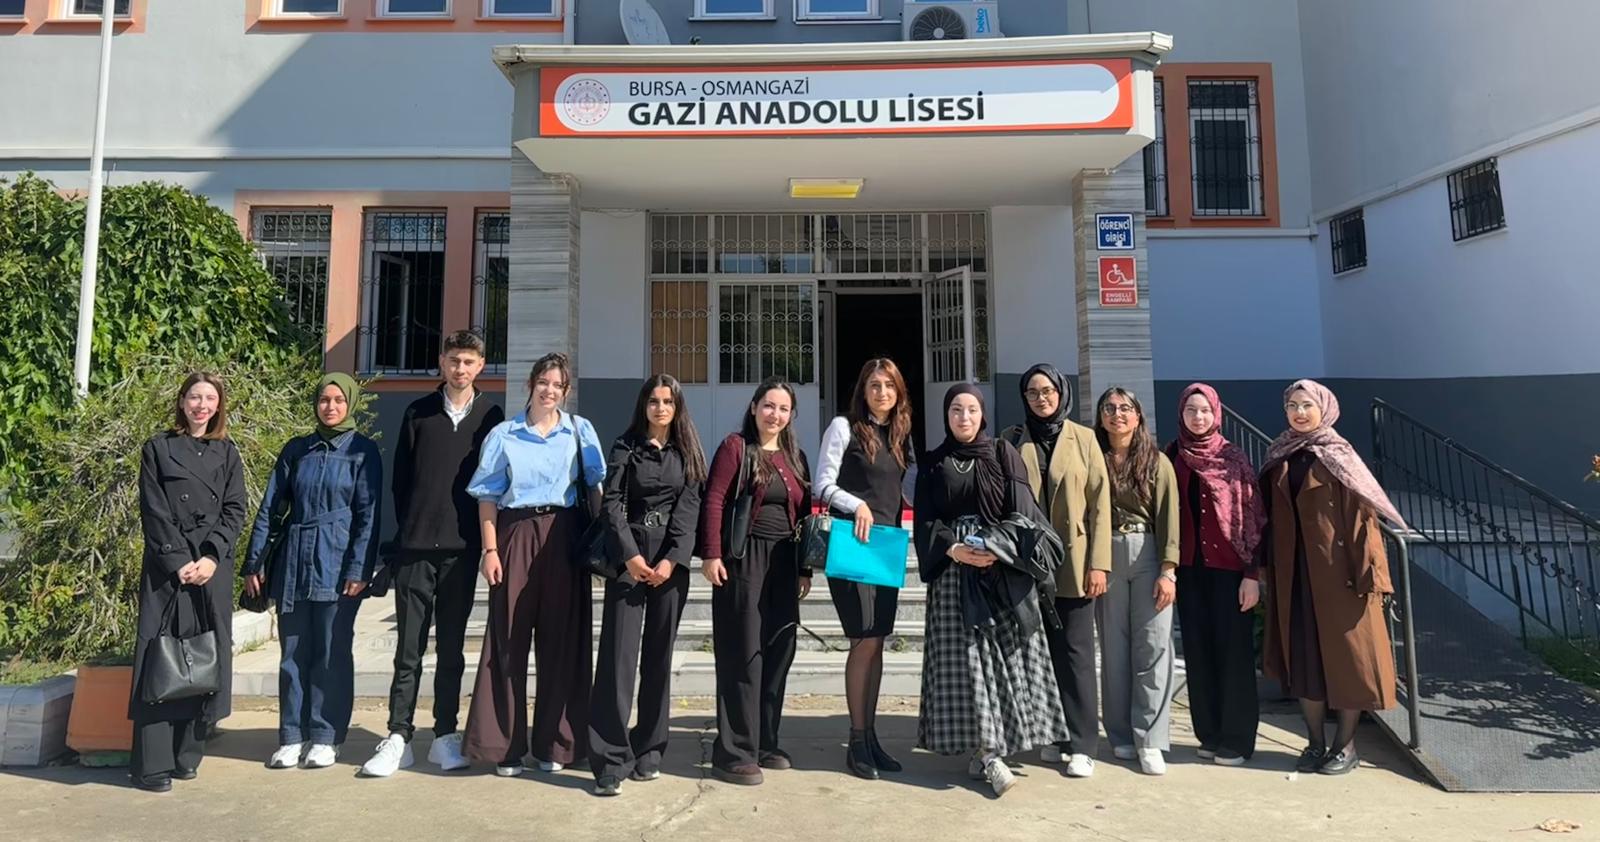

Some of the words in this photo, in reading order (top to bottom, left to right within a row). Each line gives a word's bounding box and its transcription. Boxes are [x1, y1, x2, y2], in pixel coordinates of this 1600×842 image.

[976, 8, 984, 33] beko
[629, 81, 687, 97] BURSA
[702, 77, 809, 96] OSMANGAZİ
[628, 97, 706, 125] GAZİ
[715, 100, 878, 125] ANADOLU
[889, 91, 984, 122] LİSESİ
